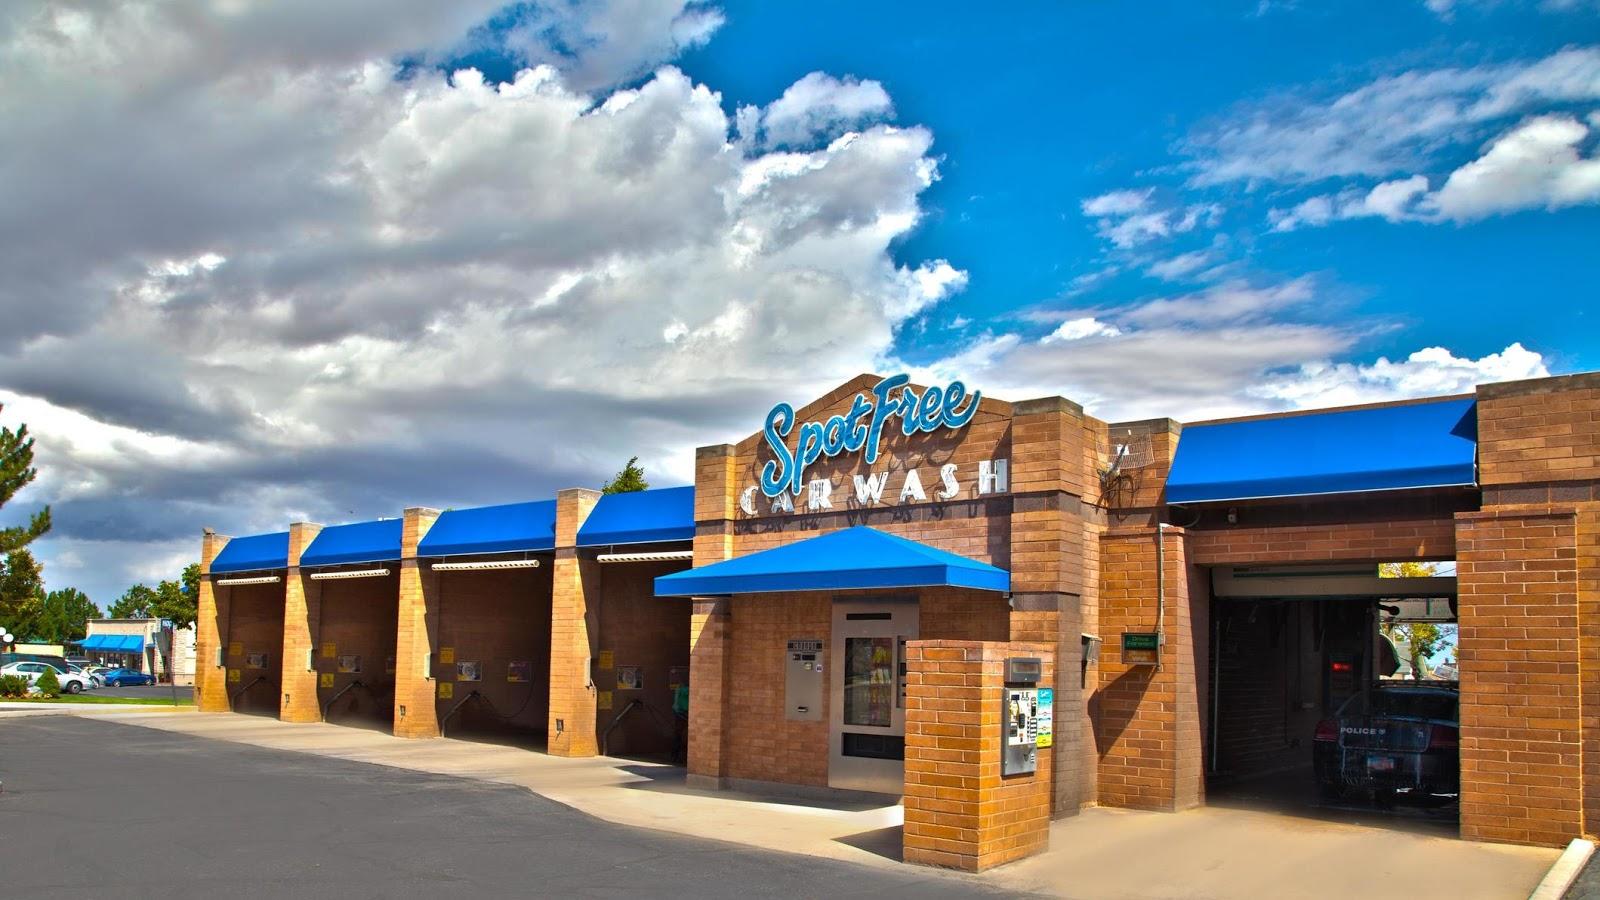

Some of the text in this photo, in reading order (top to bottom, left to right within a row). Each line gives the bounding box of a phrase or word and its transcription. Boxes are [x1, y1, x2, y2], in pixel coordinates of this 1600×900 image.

[740, 459, 1007, 514] CAR WASH
[1340, 727, 1377, 735] POLICE
